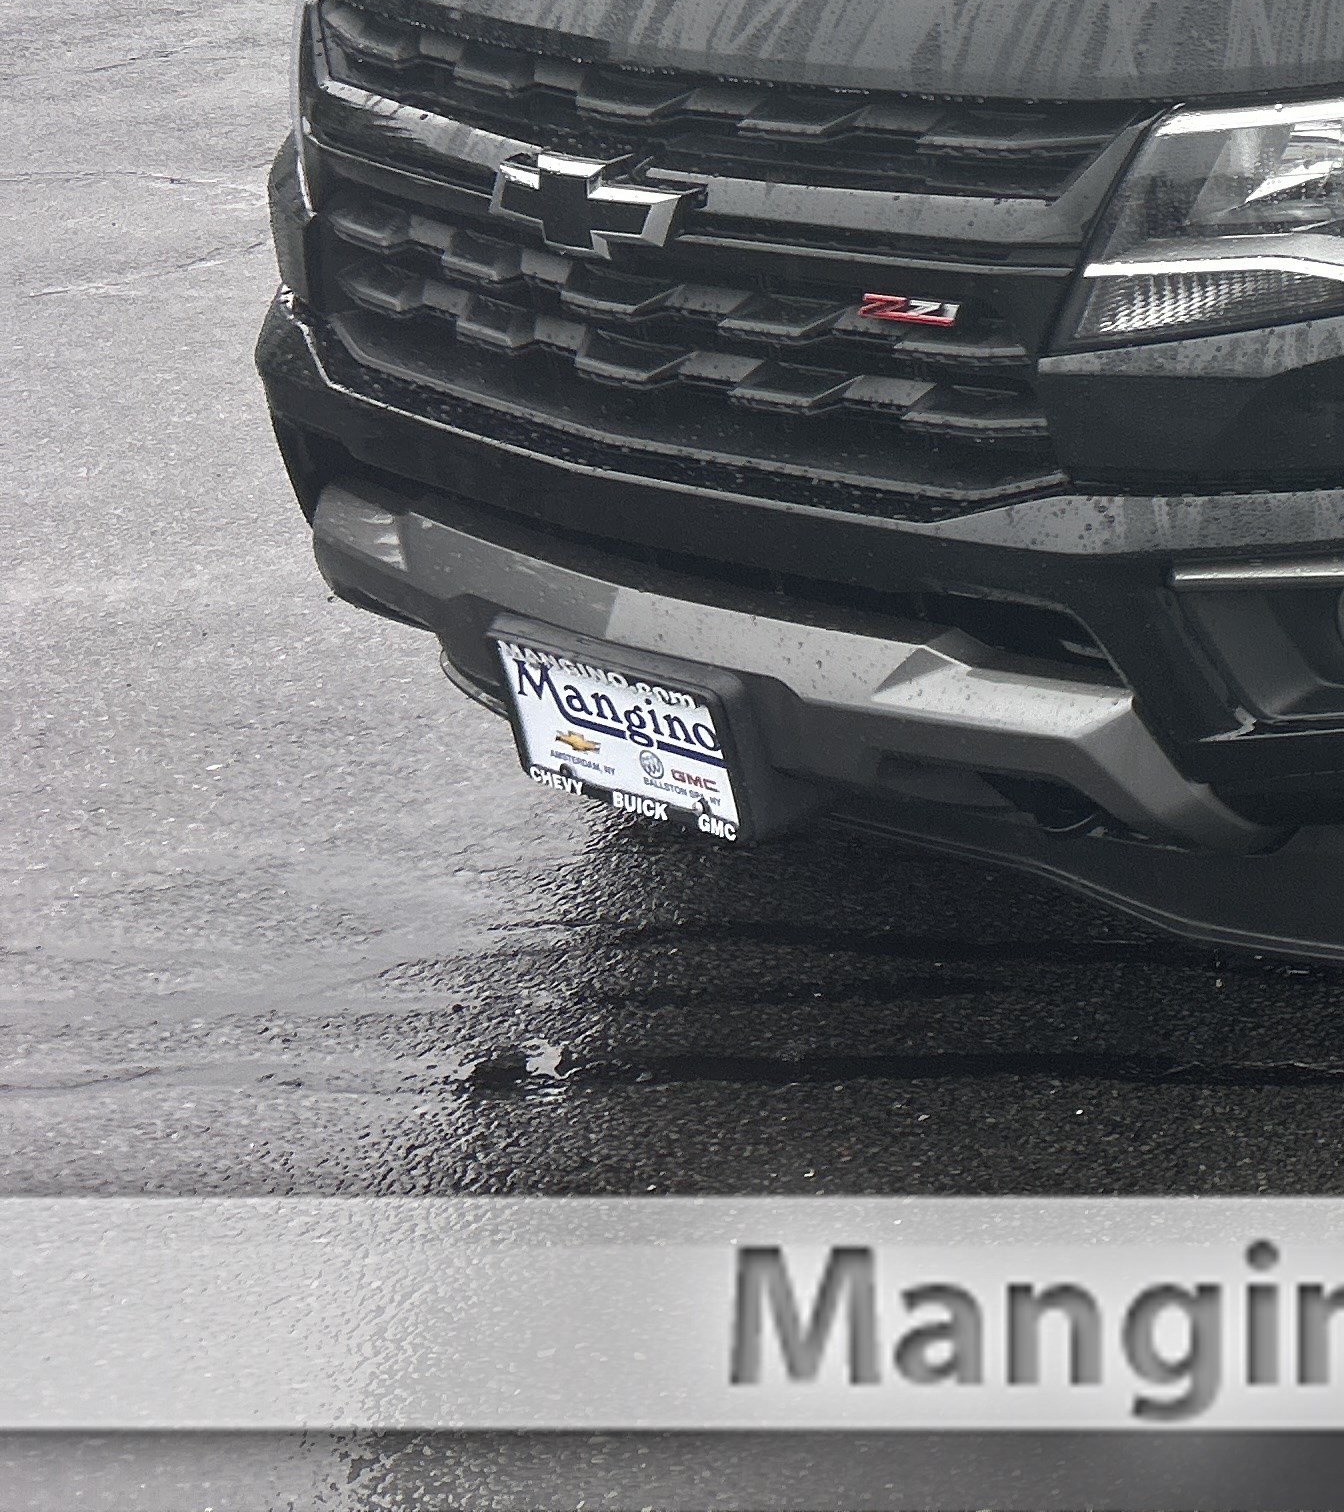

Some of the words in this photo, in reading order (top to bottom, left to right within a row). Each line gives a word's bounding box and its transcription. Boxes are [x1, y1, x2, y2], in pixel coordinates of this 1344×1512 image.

[858, 292, 960, 326] Z71
[511, 657, 724, 756] Mangino
[529, 765, 583, 796] CHEVY
[670, 768, 720, 793] GMC
[612, 790, 669, 821] BUICK
[698, 813, 737, 841] GMC
